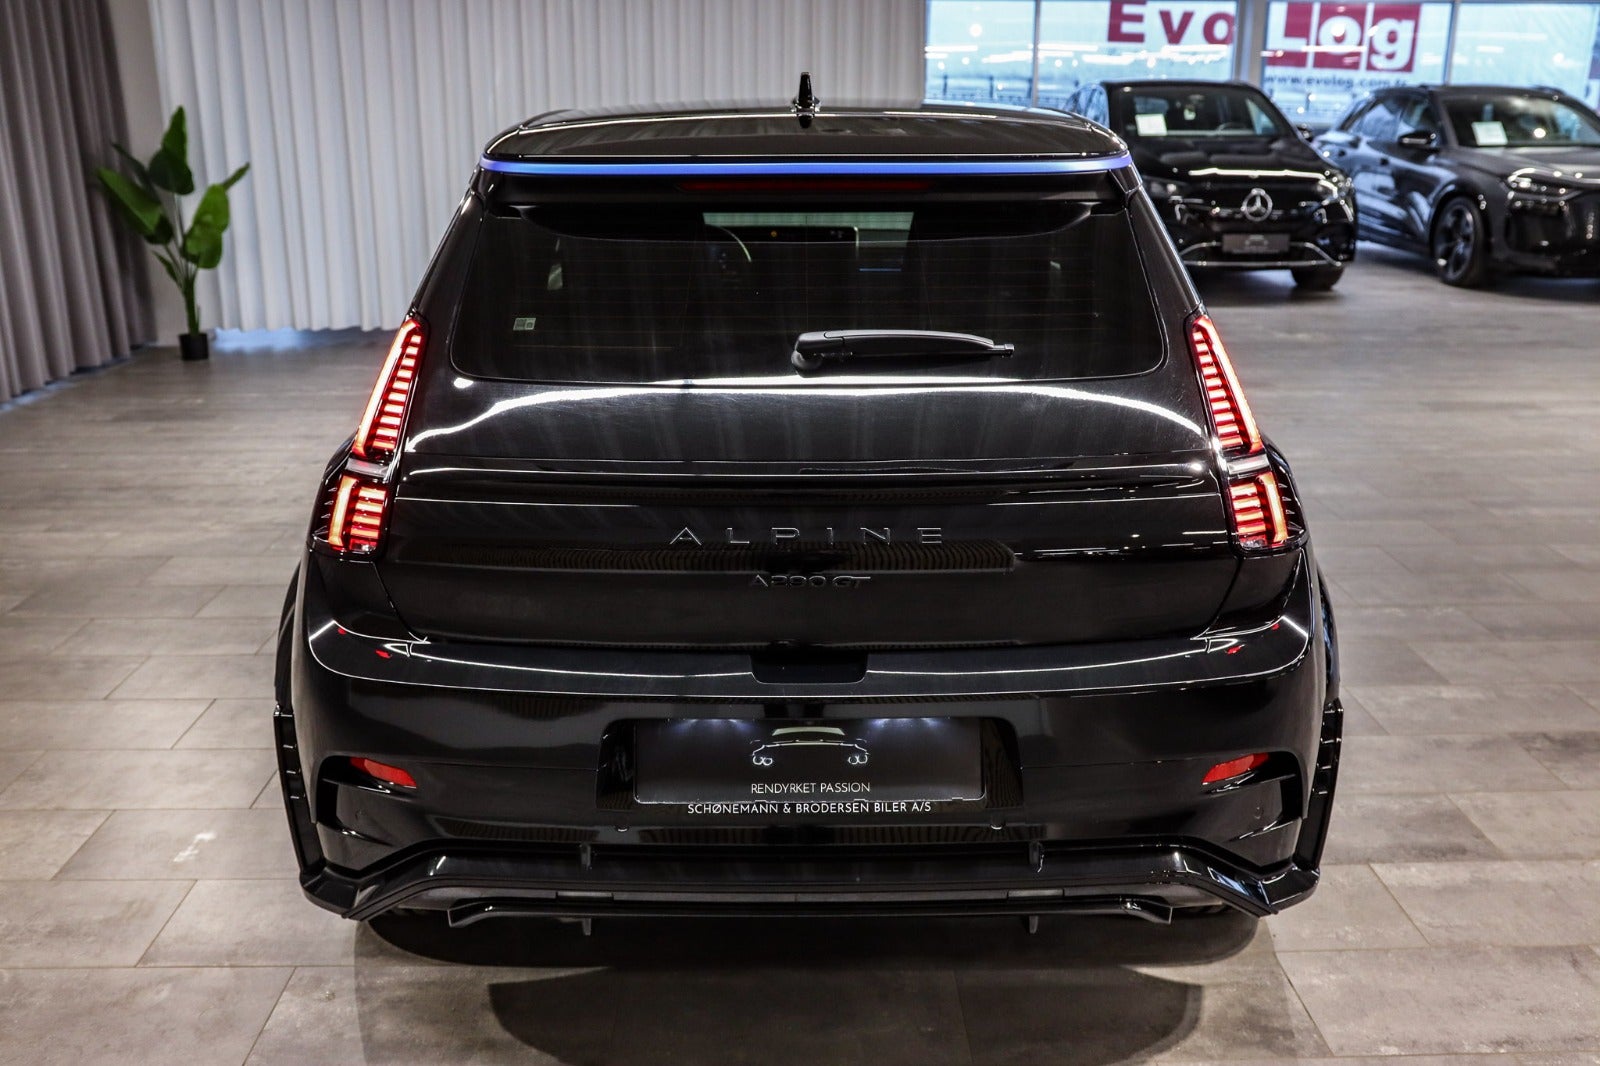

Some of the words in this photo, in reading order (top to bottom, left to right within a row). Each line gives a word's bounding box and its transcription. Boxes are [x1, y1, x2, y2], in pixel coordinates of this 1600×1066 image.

[1107, 0, 1236, 45] Evo
[1266, 2, 1416, 70] Log
[669, 526, 942, 546] ALPINE
[832, 574, 871, 588] GT
[751, 782, 816, 794] RENDYRKET
[820, 782, 871, 793] PASSION
[687, 802, 779, 814] SCHØNEMANN
[783, 803, 791, 814] &
[795, 802, 869, 814] BRODERSEN
[874, 801, 907, 813] BILER
[911, 801, 931, 813] A/S
